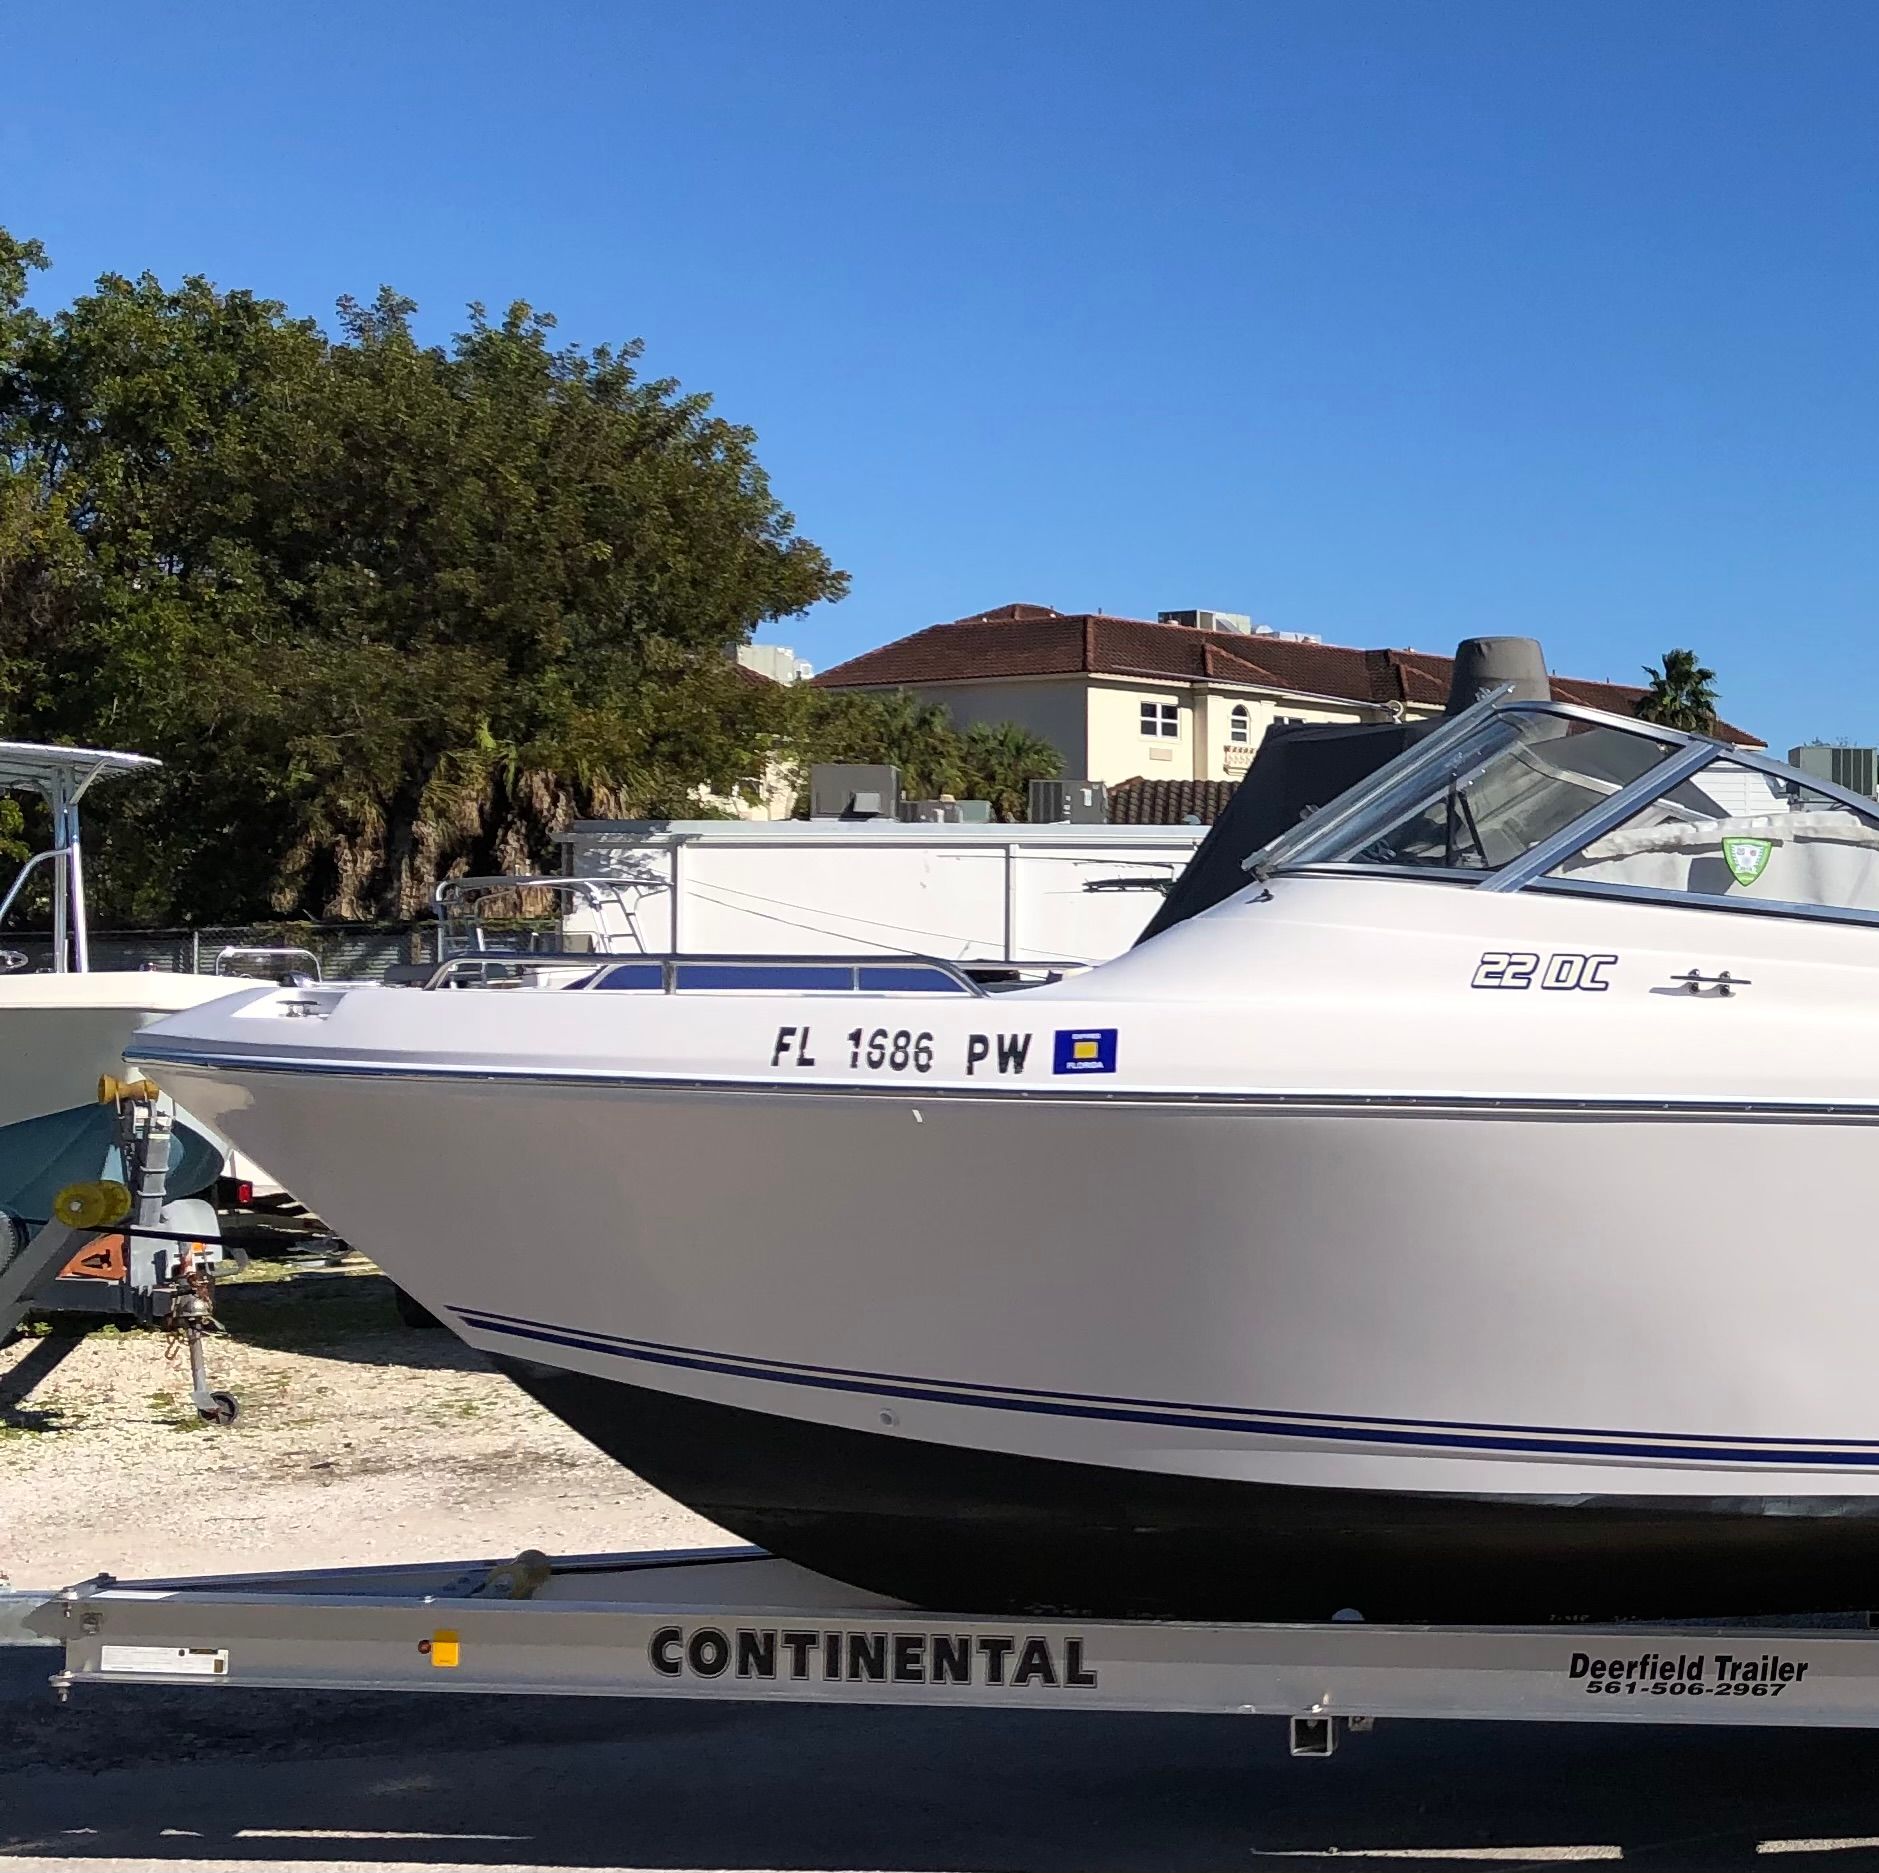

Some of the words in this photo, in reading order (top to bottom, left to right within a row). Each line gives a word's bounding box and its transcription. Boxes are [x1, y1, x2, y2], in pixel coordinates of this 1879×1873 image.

[1471, 952, 1540, 989] 22
[1541, 953, 1618, 991] DC
[771, 1026, 815, 1066] FL
[847, 1028, 934, 1073] 1686
[966, 1033, 1033, 1075] PW
[648, 1626, 1098, 1688] CONTINENTAL
[1569, 1653, 1705, 1681] Deerfield
[1714, 1654, 1808, 1683] Trailer
[1586, 1681, 1786, 1697] 561-506-2967
